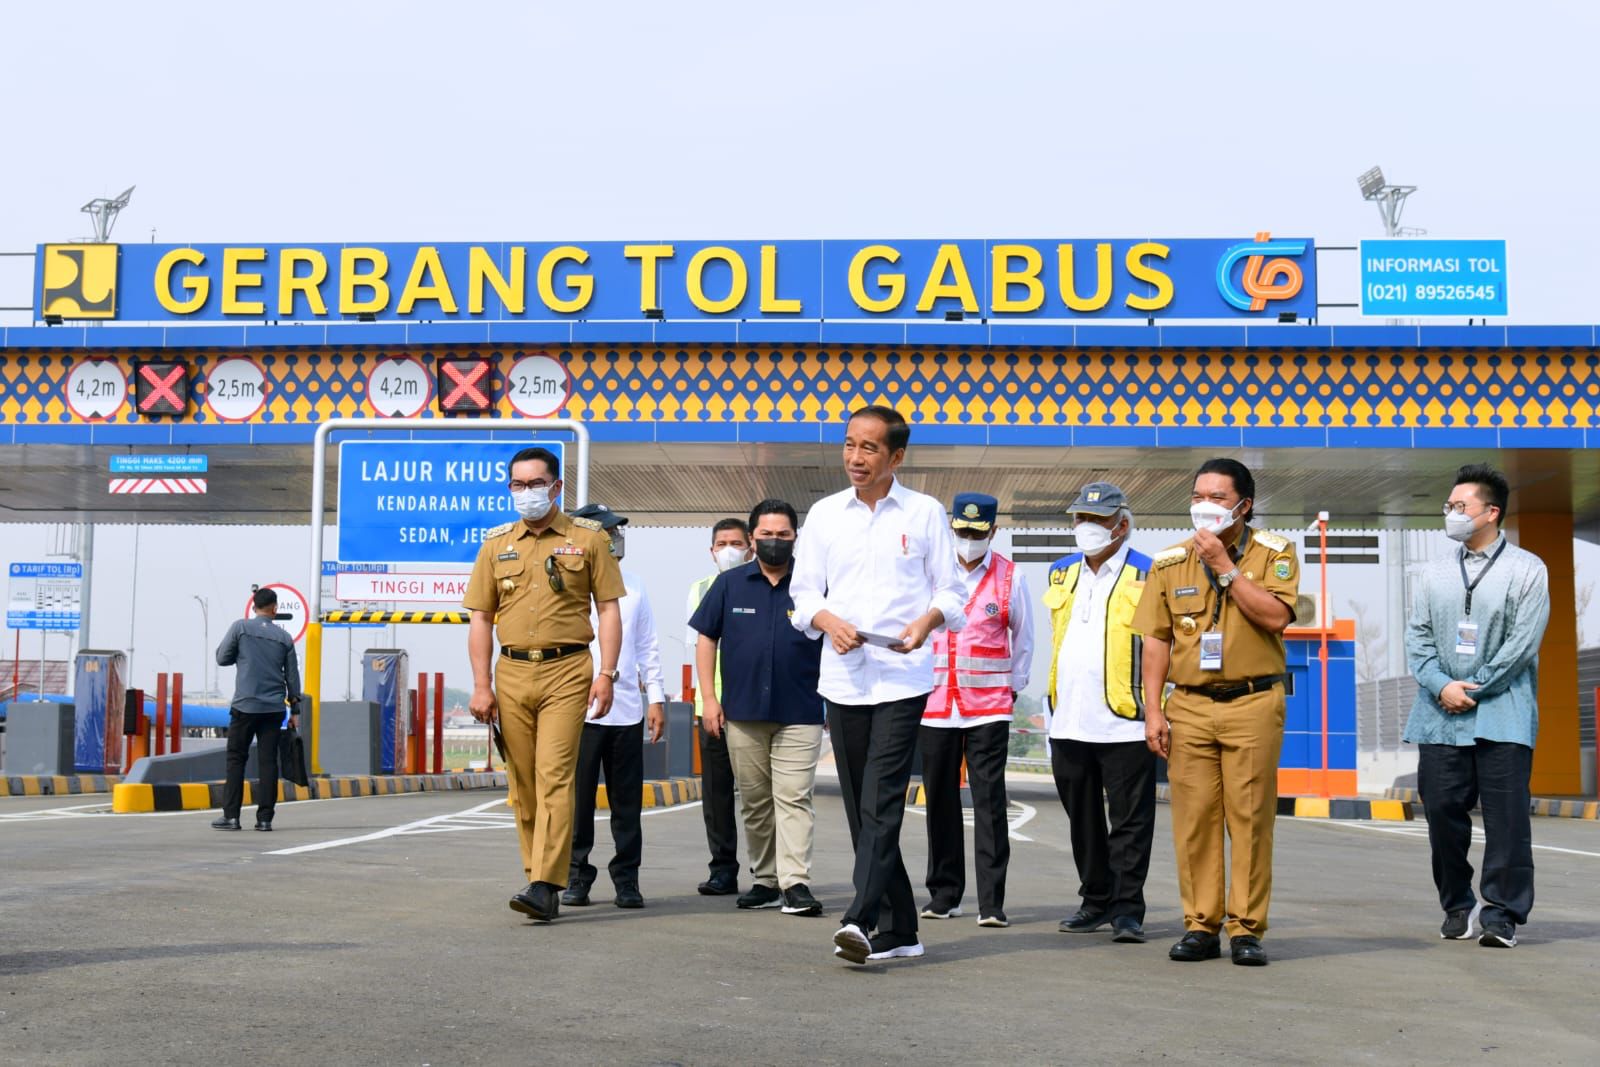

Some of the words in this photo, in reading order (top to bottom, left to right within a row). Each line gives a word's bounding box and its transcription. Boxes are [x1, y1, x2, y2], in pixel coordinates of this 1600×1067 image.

[1367, 258, 1460, 272] INFORMASI
[1468, 258, 1500, 272] TOL
[154, 246, 594, 314] GERBANG
[624, 245, 802, 313] TOL
[848, 243, 1174, 313] GABUS
[1367, 282, 1407, 302] (021)
[1415, 285, 1495, 300] 89526545
[76, 379, 116, 399] 4,2m
[217, 379, 255, 400] 2,5m
[380, 377, 418, 398] 4,2m
[519, 376, 557, 397] 2,5m
[361, 461, 433, 482] LAJUR
[446, 461, 507, 482] KHUS
[377, 495, 470, 511] KENDARAAN
[477, 496, 514, 511] KECI
[399, 527, 455, 546] SEDAN,
[462, 528, 488, 543] JEE
[22, 565, 45, 573] TARIF
[47, 565, 62, 573] TOL
[326, 564, 349, 572] TARIF
[371, 581, 424, 594] TINGGI
[433, 581, 468, 594] MAK
